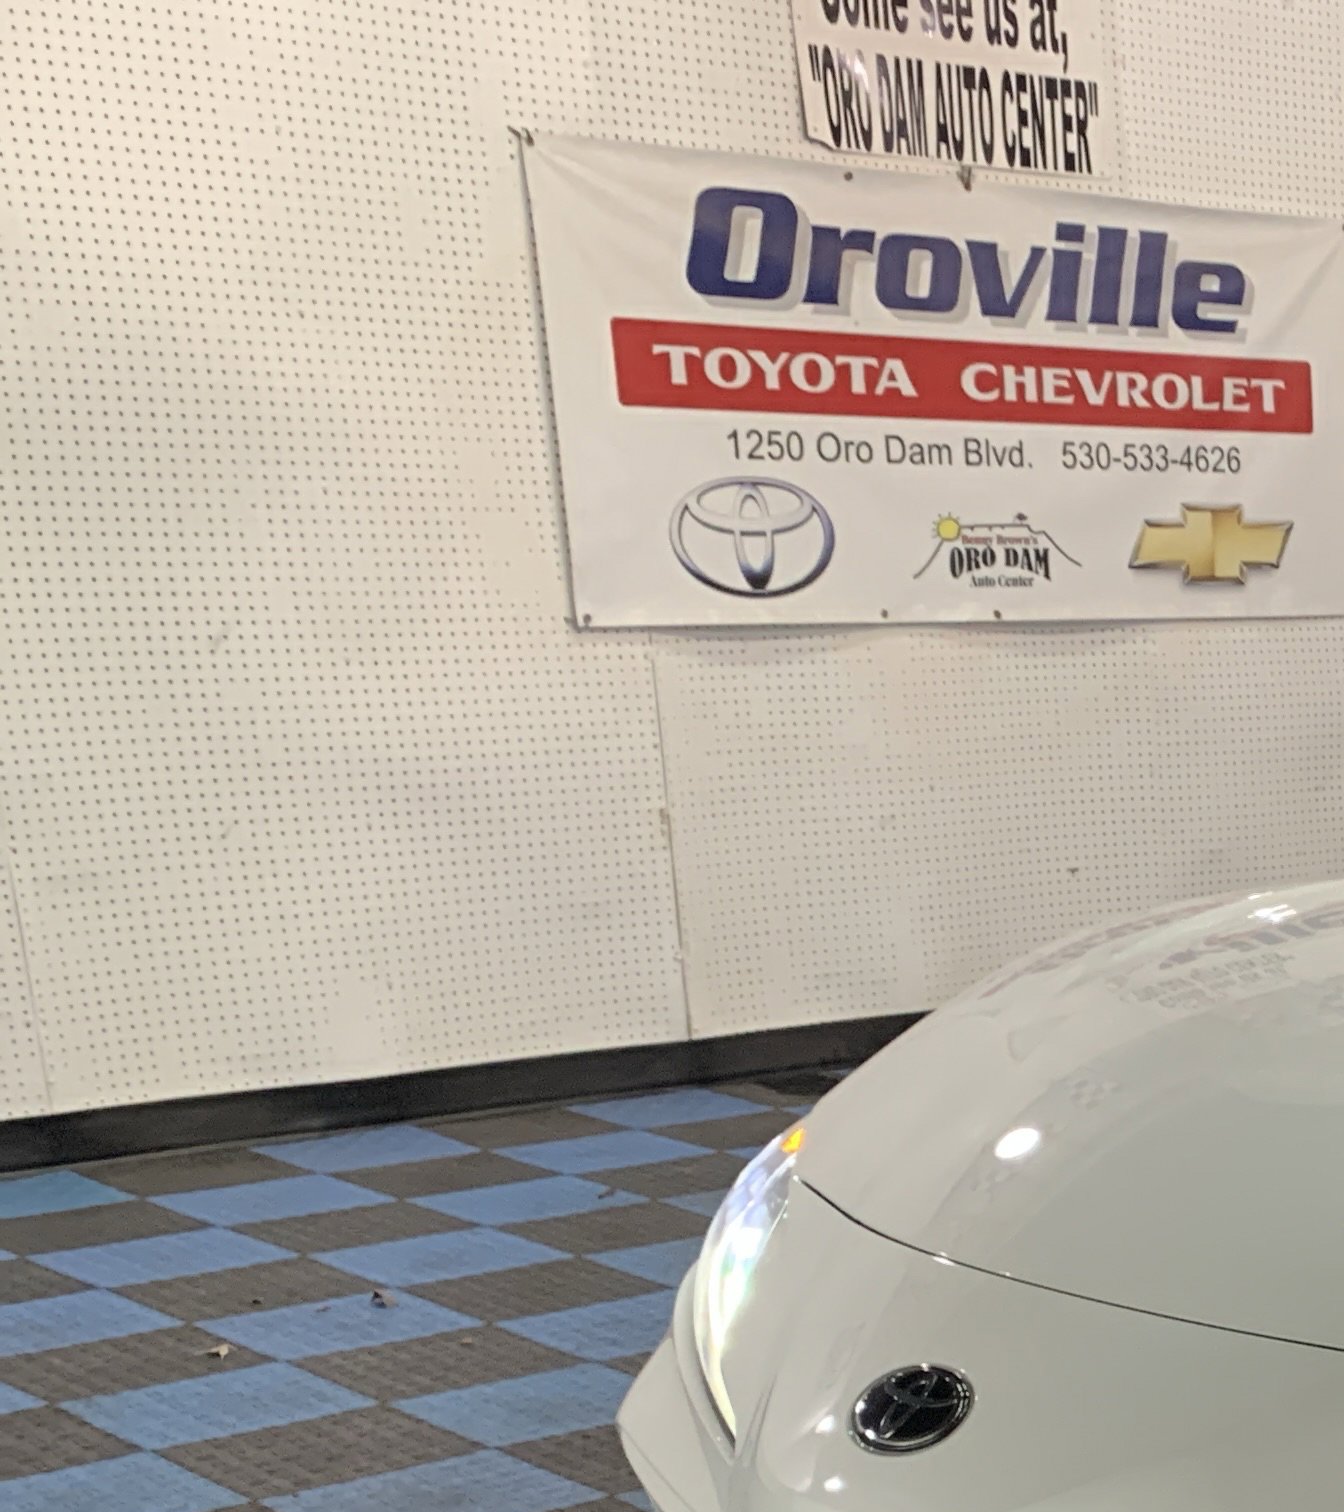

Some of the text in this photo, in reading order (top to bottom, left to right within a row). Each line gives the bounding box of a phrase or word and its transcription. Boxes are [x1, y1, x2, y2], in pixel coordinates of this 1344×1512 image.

[821, 0, 909, 33] ome
[984, 0, 1019, 48] us
[876, 53, 928, 158] DAM
[935, 61, 994, 165] AUTO
[1000, 69, 1099, 175] CENTER"
[686, 186, 1250, 338] Oroville
[652, 344, 1286, 415] TOYOTA CHEVROLET
[727, 428, 1241, 474] 1250 Oro Dam Blvd. 530-533-4626
[950, 546, 1052, 581] ORO DAM
[970, 575, 1034, 588] Auto Center
